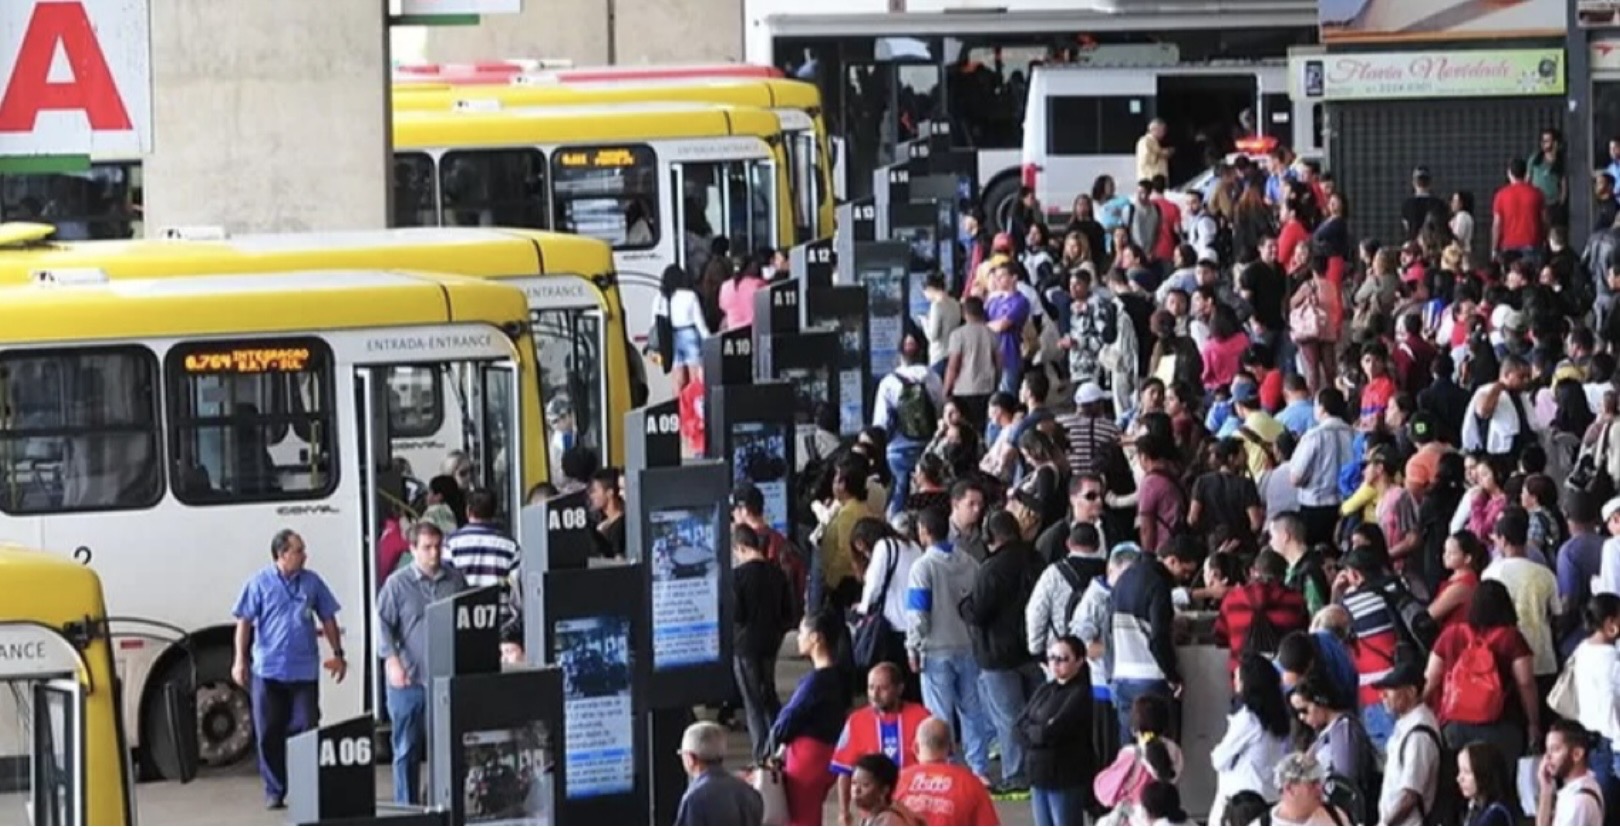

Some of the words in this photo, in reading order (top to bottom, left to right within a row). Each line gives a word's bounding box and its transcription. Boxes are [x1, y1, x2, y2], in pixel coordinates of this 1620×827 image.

[0, 2, 133, 131] A
[890, 170, 897, 183] A
[854, 205, 862, 219] A
[863, 205, 875, 219] 13
[808, 249, 816, 263] A
[818, 248, 831, 263] 12
[774, 291, 783, 305] A
[785, 290, 796, 305] 11
[723, 339, 734, 355] A
[736, 339, 751, 355] 10
[647, 415, 658, 434] A
[659, 413, 679, 434] 09
[549, 510, 561, 530] A
[562, 507, 587, 529] 08
[457, 605, 471, 629] A
[473, 604, 497, 629] 07
[319, 738, 337, 766] A
[339, 736, 372, 766] 06
